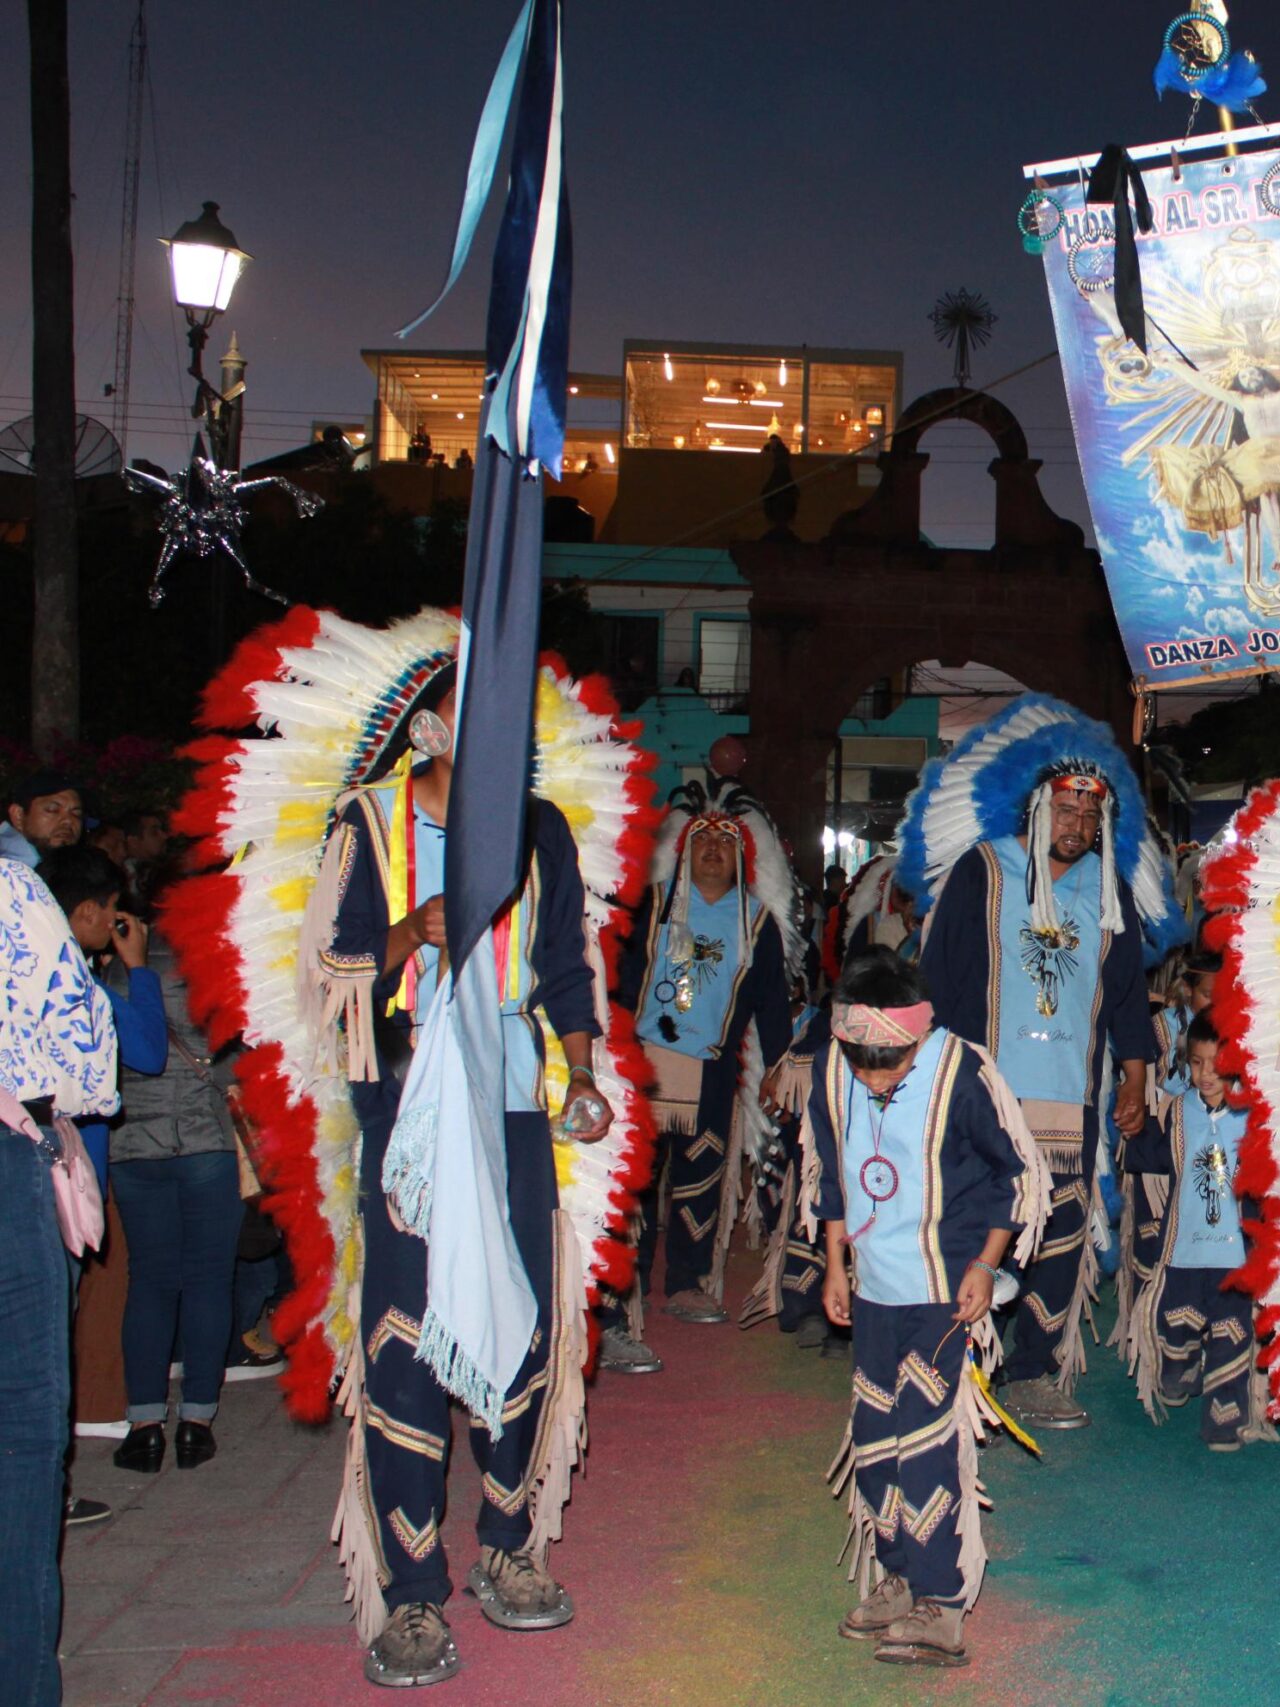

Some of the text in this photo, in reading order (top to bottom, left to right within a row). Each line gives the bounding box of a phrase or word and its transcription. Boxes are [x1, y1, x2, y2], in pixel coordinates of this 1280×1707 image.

[1165, 195, 1198, 231] AL
[1205, 188, 1248, 226] SR.
[1149, 638, 1235, 667] DANZA
